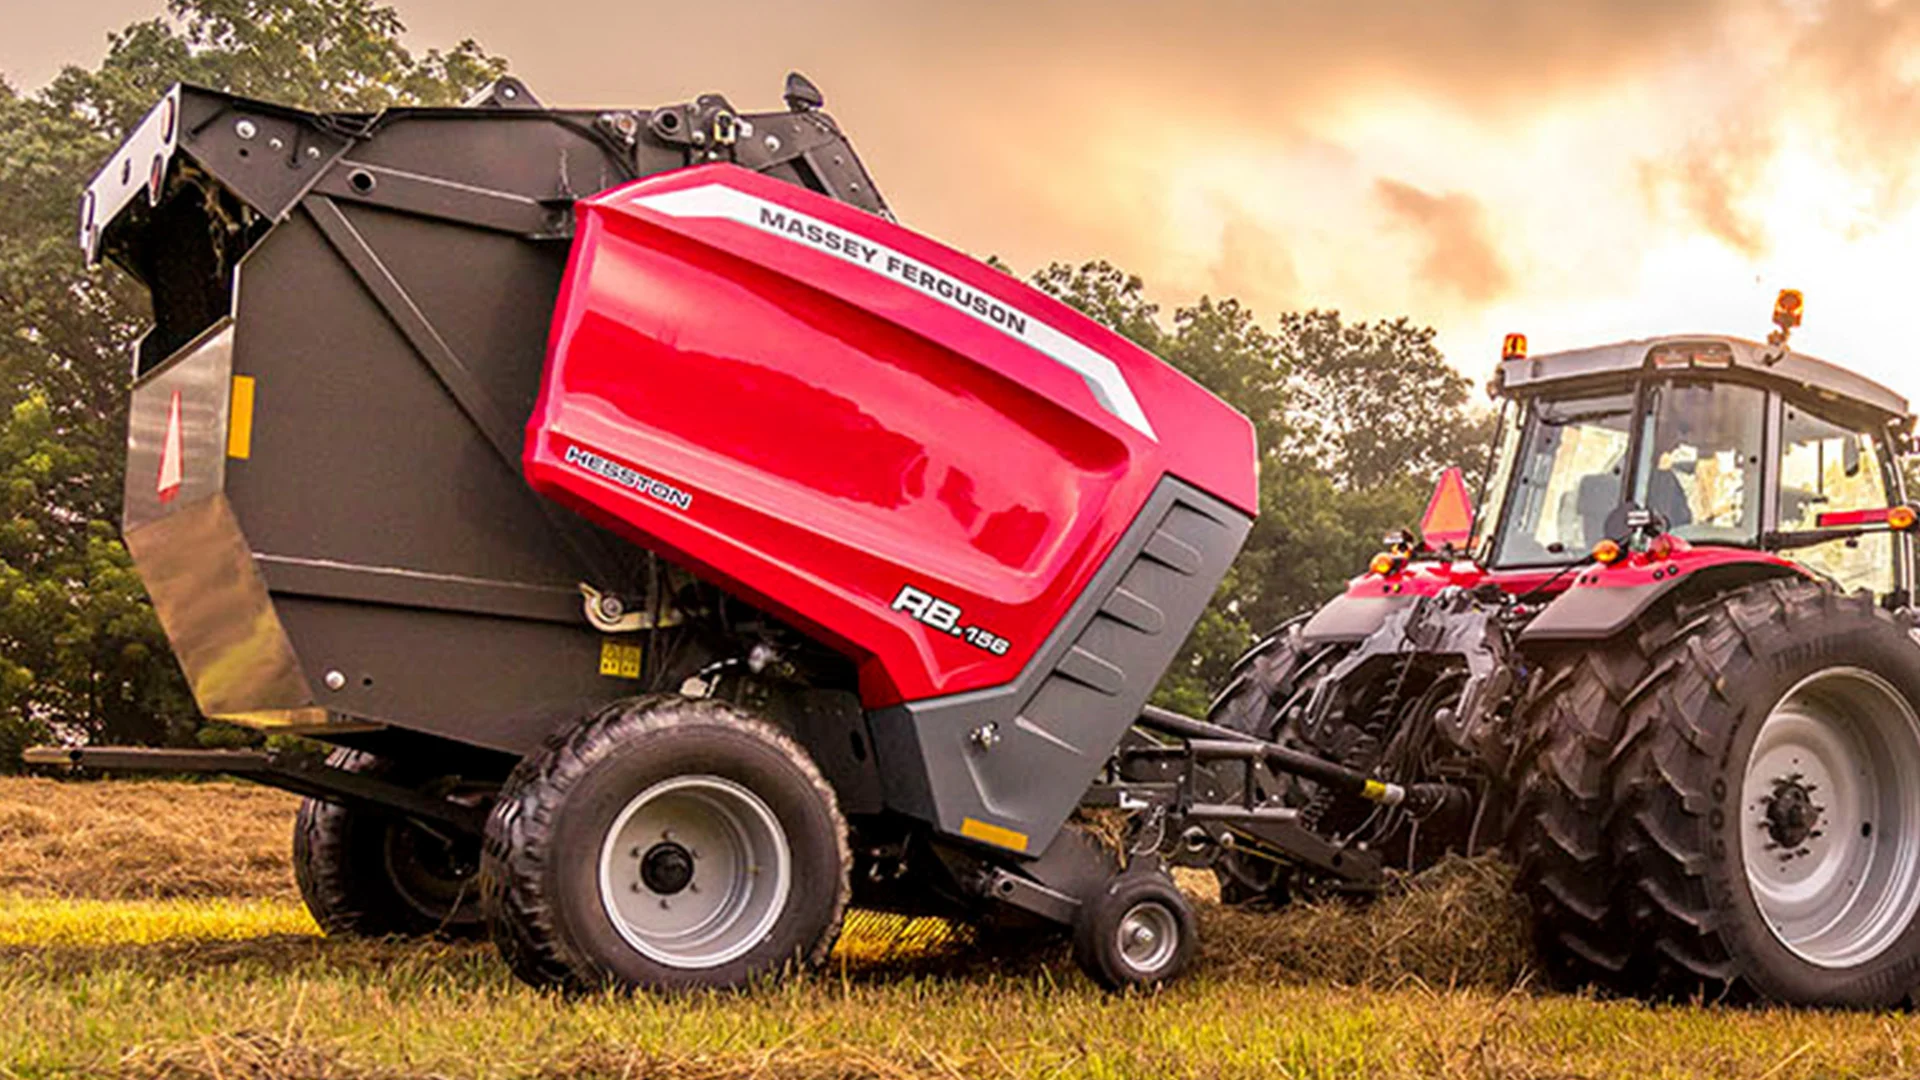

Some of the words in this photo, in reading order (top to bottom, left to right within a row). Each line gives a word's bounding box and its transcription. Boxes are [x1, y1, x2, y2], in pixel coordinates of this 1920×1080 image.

[759, 207, 878, 264] MASSEY
[886, 256, 1026, 335] FERGUSON
[565, 444, 693, 510] HESSTON
